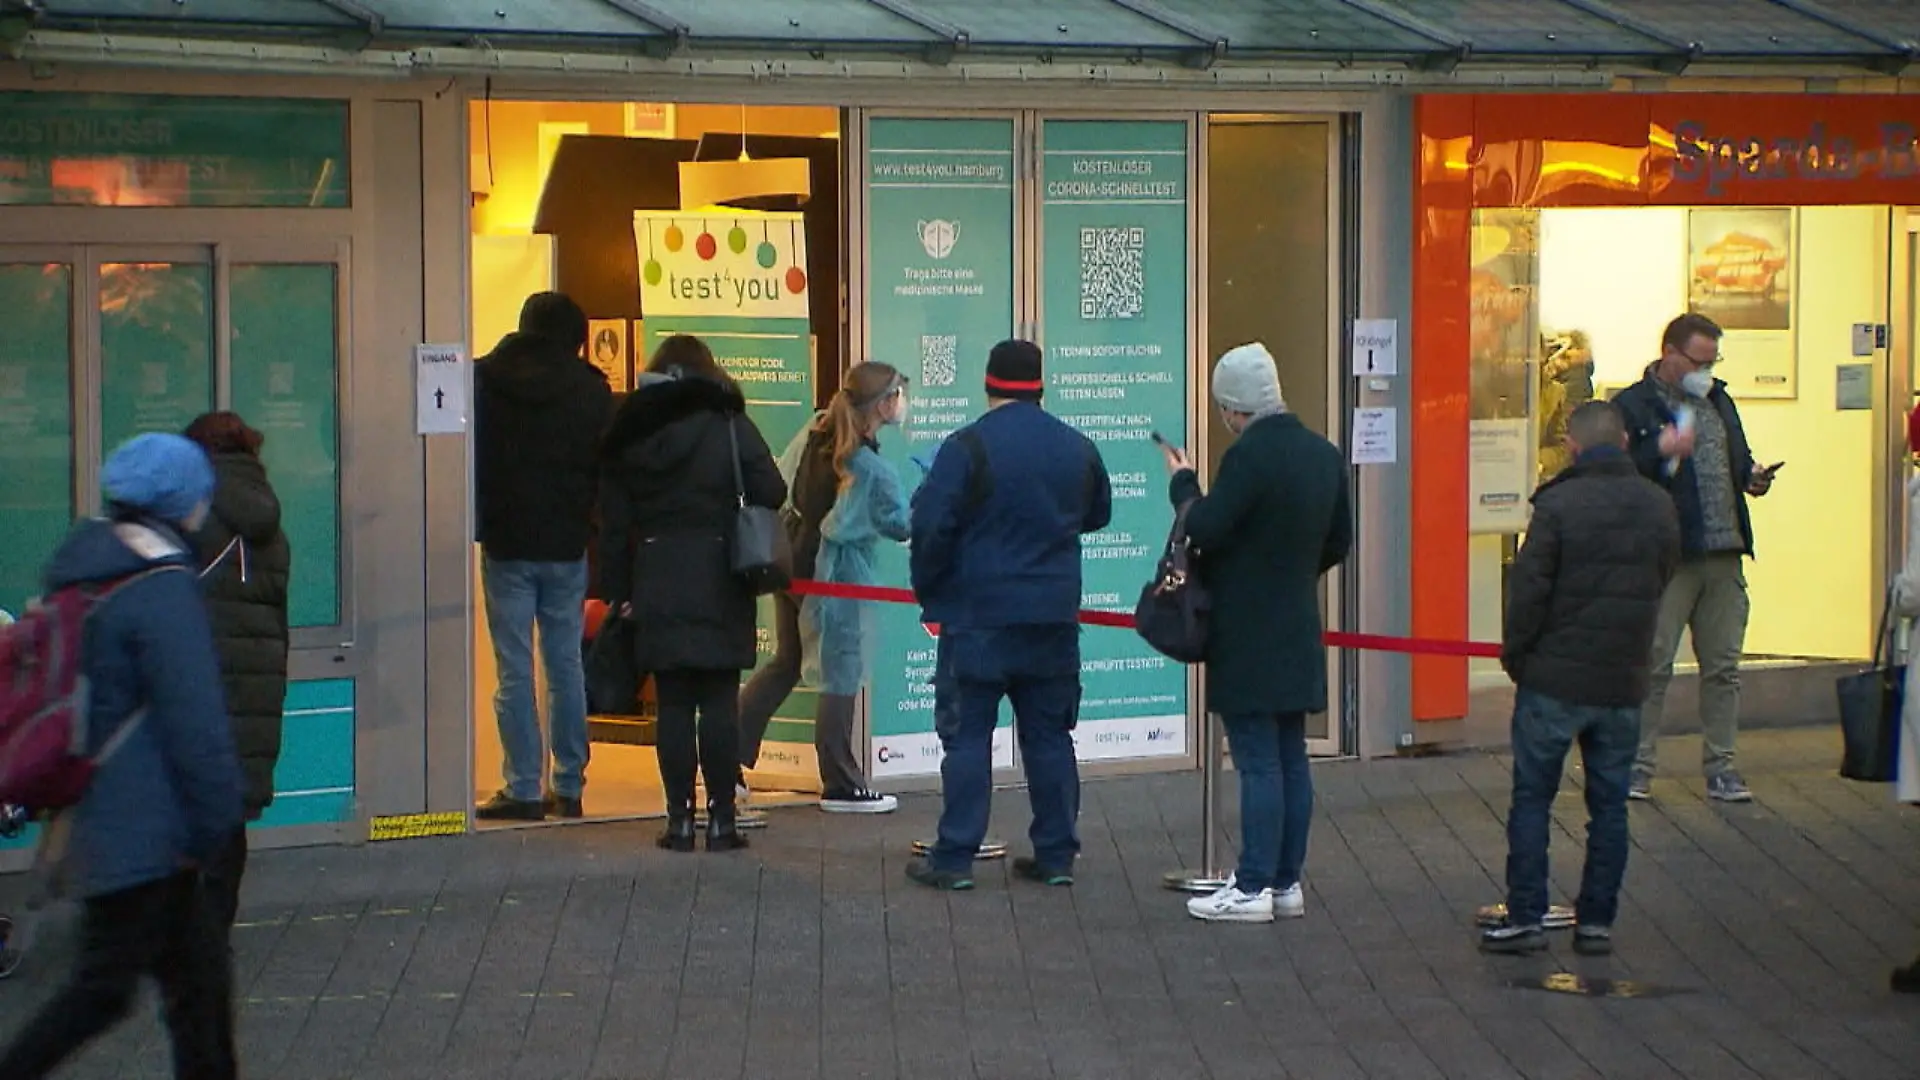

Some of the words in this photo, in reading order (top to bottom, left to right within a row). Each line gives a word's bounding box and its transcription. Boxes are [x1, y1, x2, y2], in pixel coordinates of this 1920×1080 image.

[0, 119, 173, 145] OSTENLOSER
[1673, 119, 1920, 196] Sparda-B
[874, 162, 1004, 180] www.test4you.hamburg
[1073, 160, 1152, 175] KOSTENLOSER
[1048, 181, 1176, 196] CORONA-SCHNELLTEST
[954, 267, 974, 279] eine
